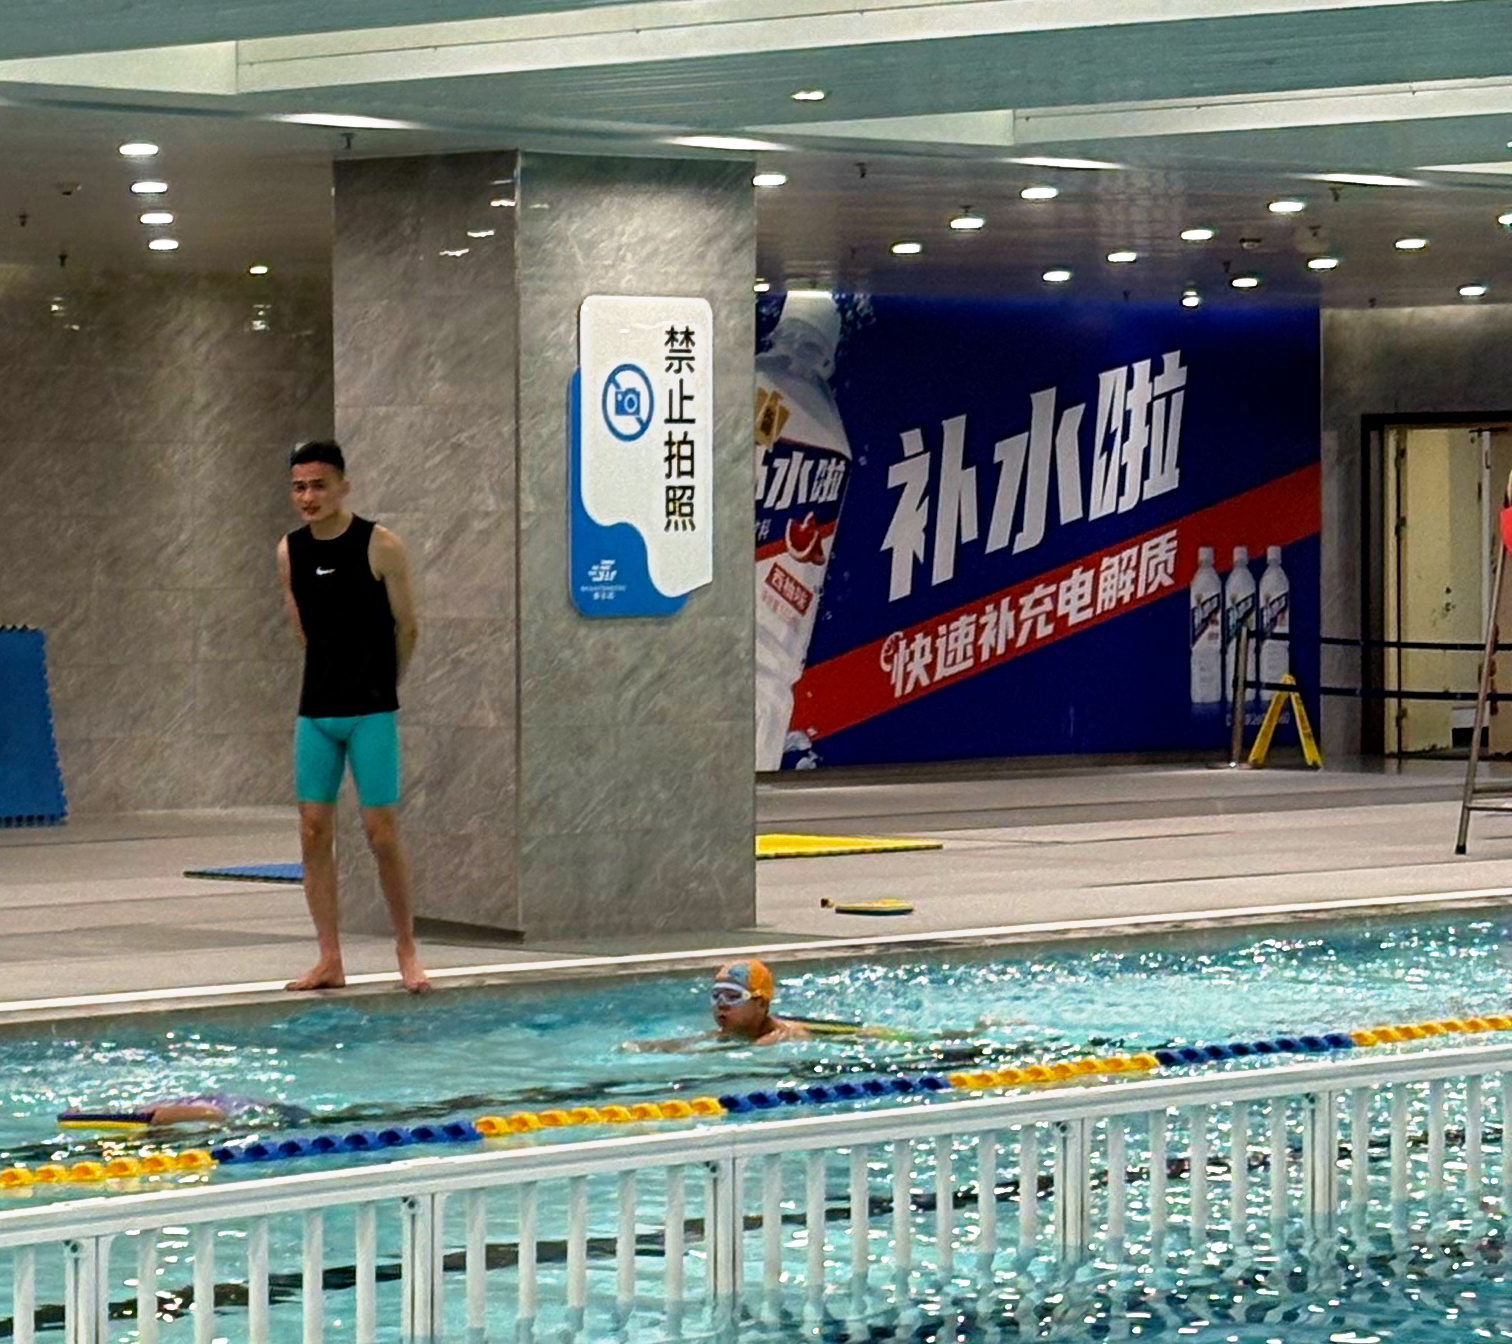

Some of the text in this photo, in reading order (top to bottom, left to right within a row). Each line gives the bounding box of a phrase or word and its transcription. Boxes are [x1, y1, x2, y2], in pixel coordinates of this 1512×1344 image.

[663, 325, 696, 532] 禁止拍照
[880, 350, 1188, 602] 补水啦
[890, 528, 1178, 698] 快速补充电解质
